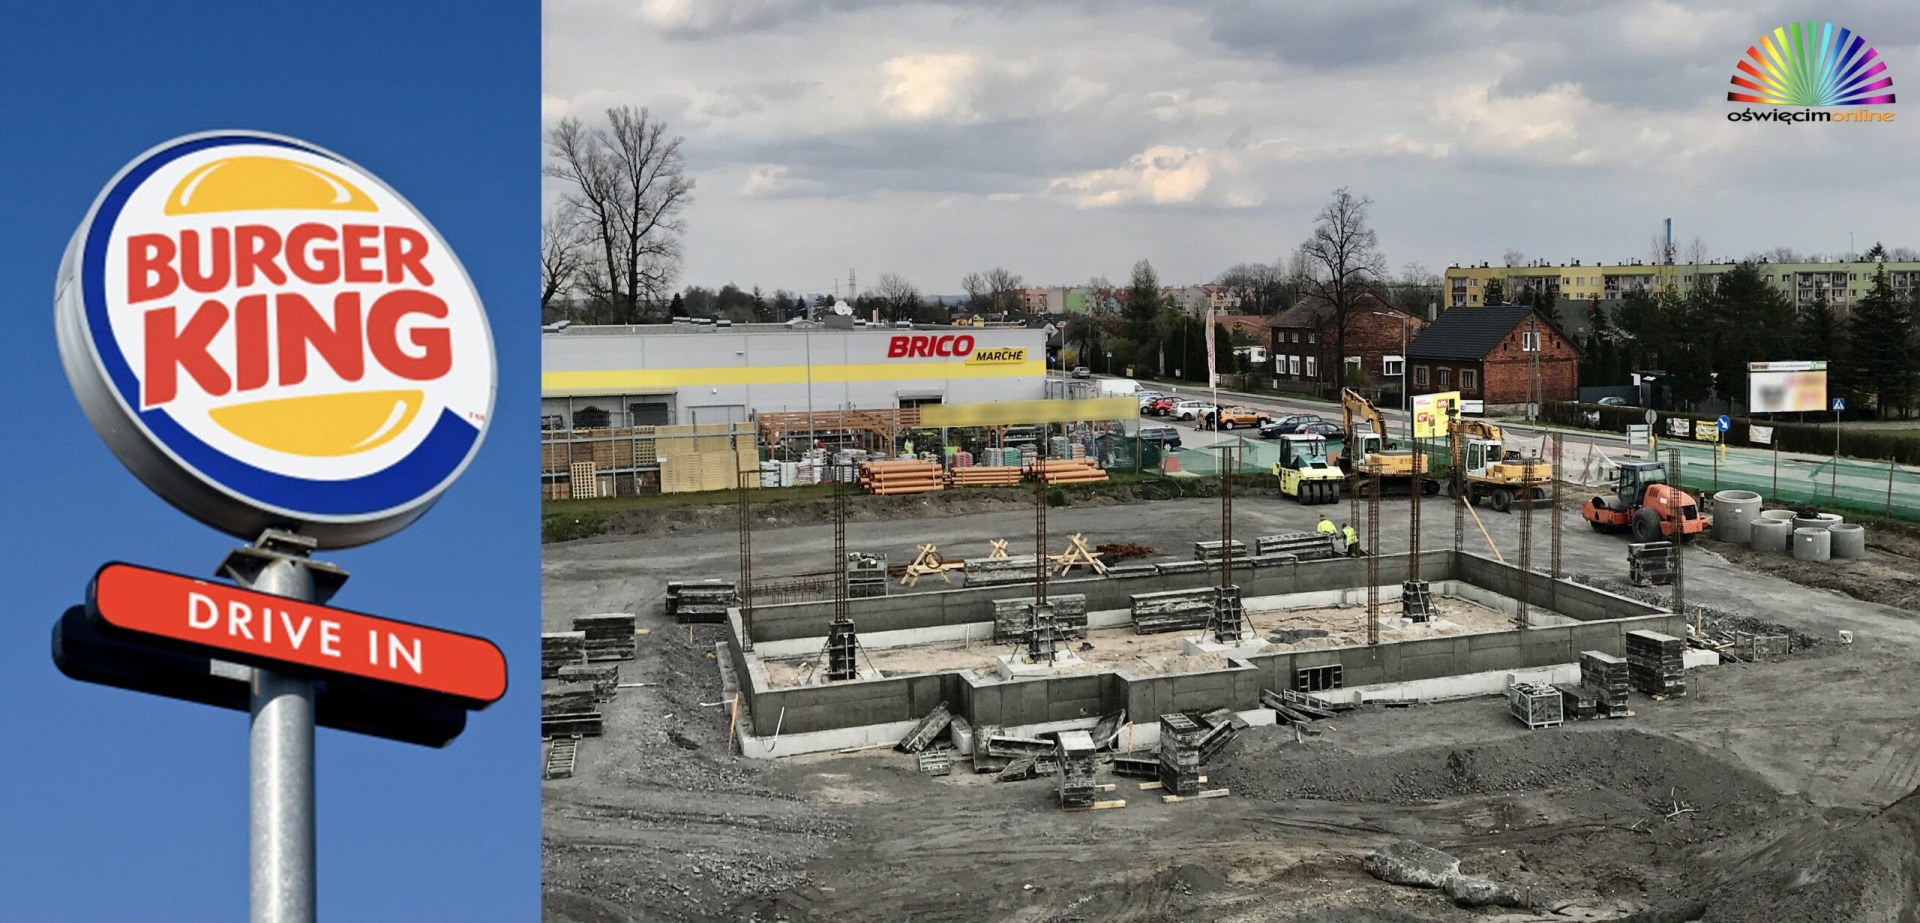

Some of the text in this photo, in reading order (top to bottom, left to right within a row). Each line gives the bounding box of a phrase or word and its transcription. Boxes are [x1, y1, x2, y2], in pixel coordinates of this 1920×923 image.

[127, 223, 434, 304] BURGER
[144, 290, 453, 406] KING
[888, 335, 975, 358] BRICO
[976, 350, 1023, 361] MARCHÉ
[189, 592, 424, 674] DRIVE IN
